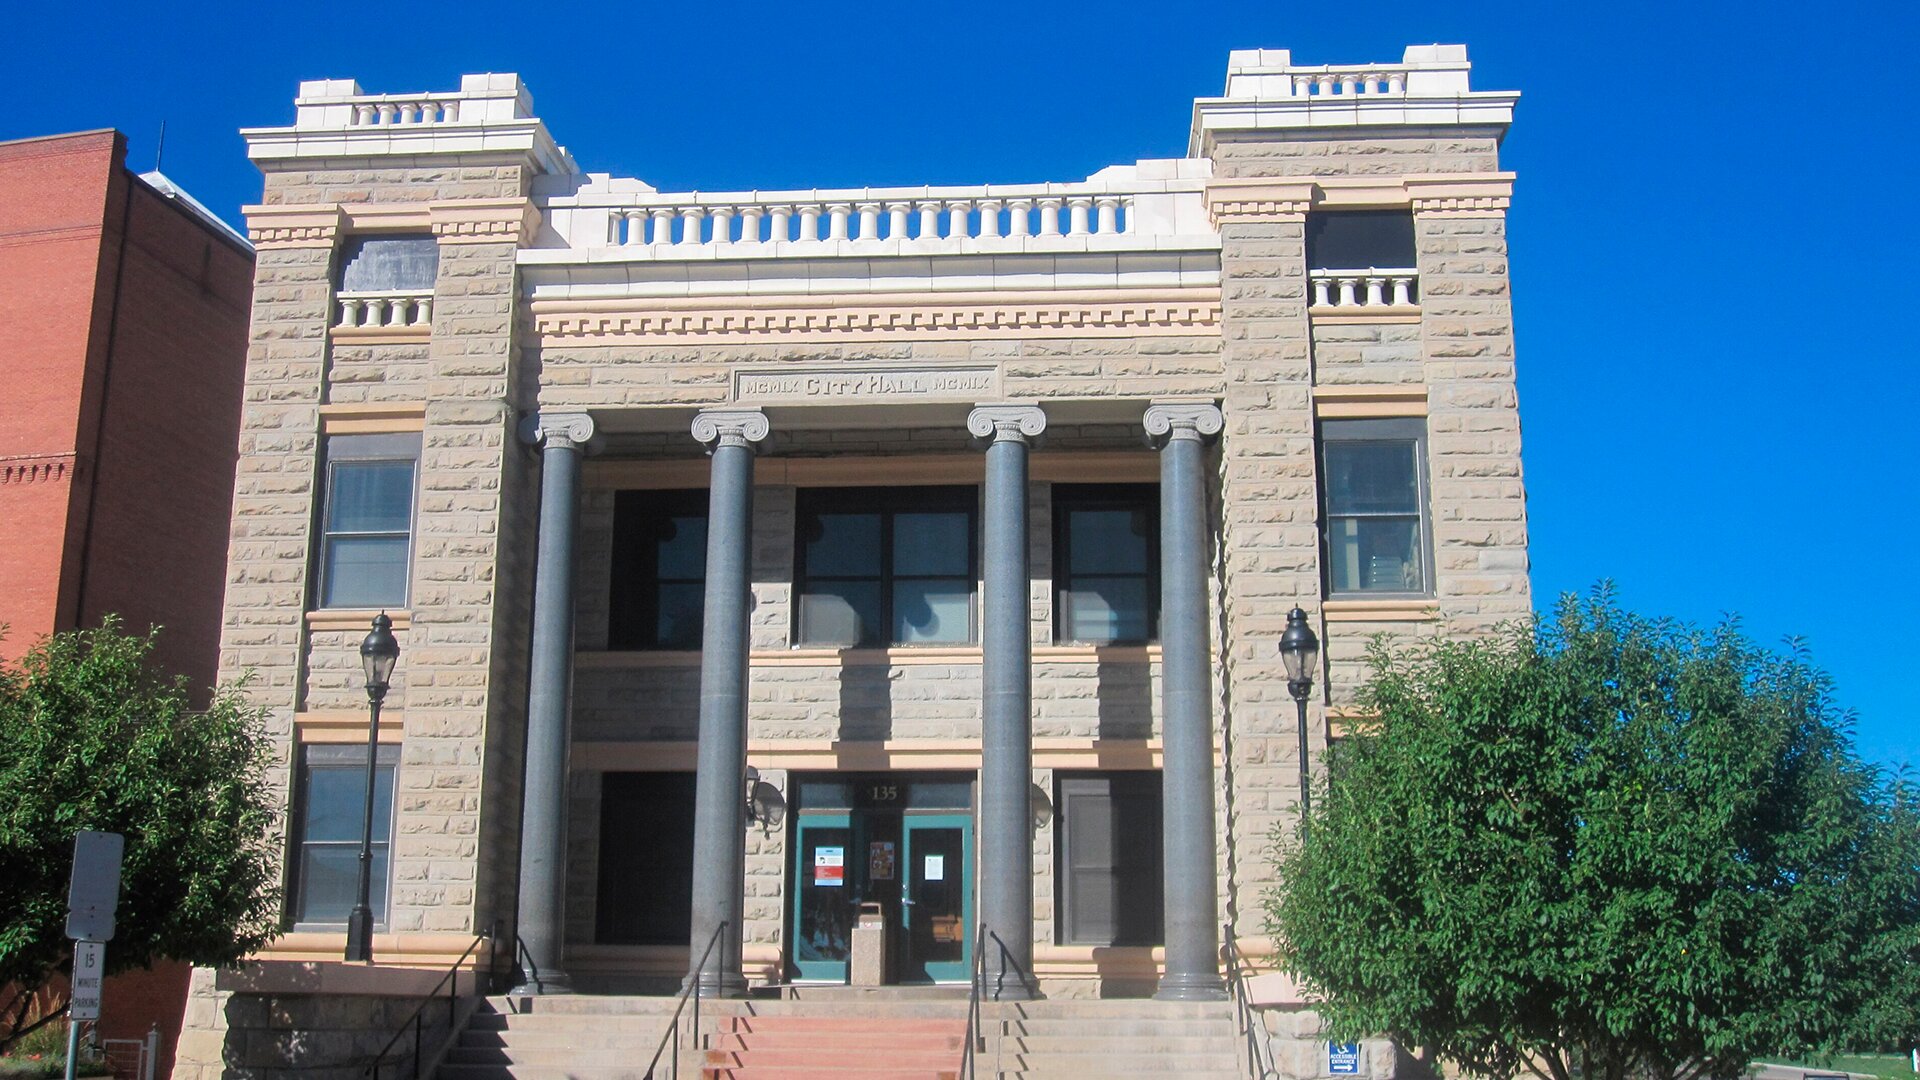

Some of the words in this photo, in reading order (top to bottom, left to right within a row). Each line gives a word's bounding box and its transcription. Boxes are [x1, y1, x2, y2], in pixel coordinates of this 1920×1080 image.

[743, 379, 799, 395] MCMIX
[805, 377, 864, 397] CITY
[867, 374, 928, 395] HALL
[933, 375, 989, 391] MCMIX
[872, 786, 897, 800] 135
[85, 953, 96, 969] 15
[77, 977, 99, 988] MINUTE
[75, 997, 99, 1008] PARKING
